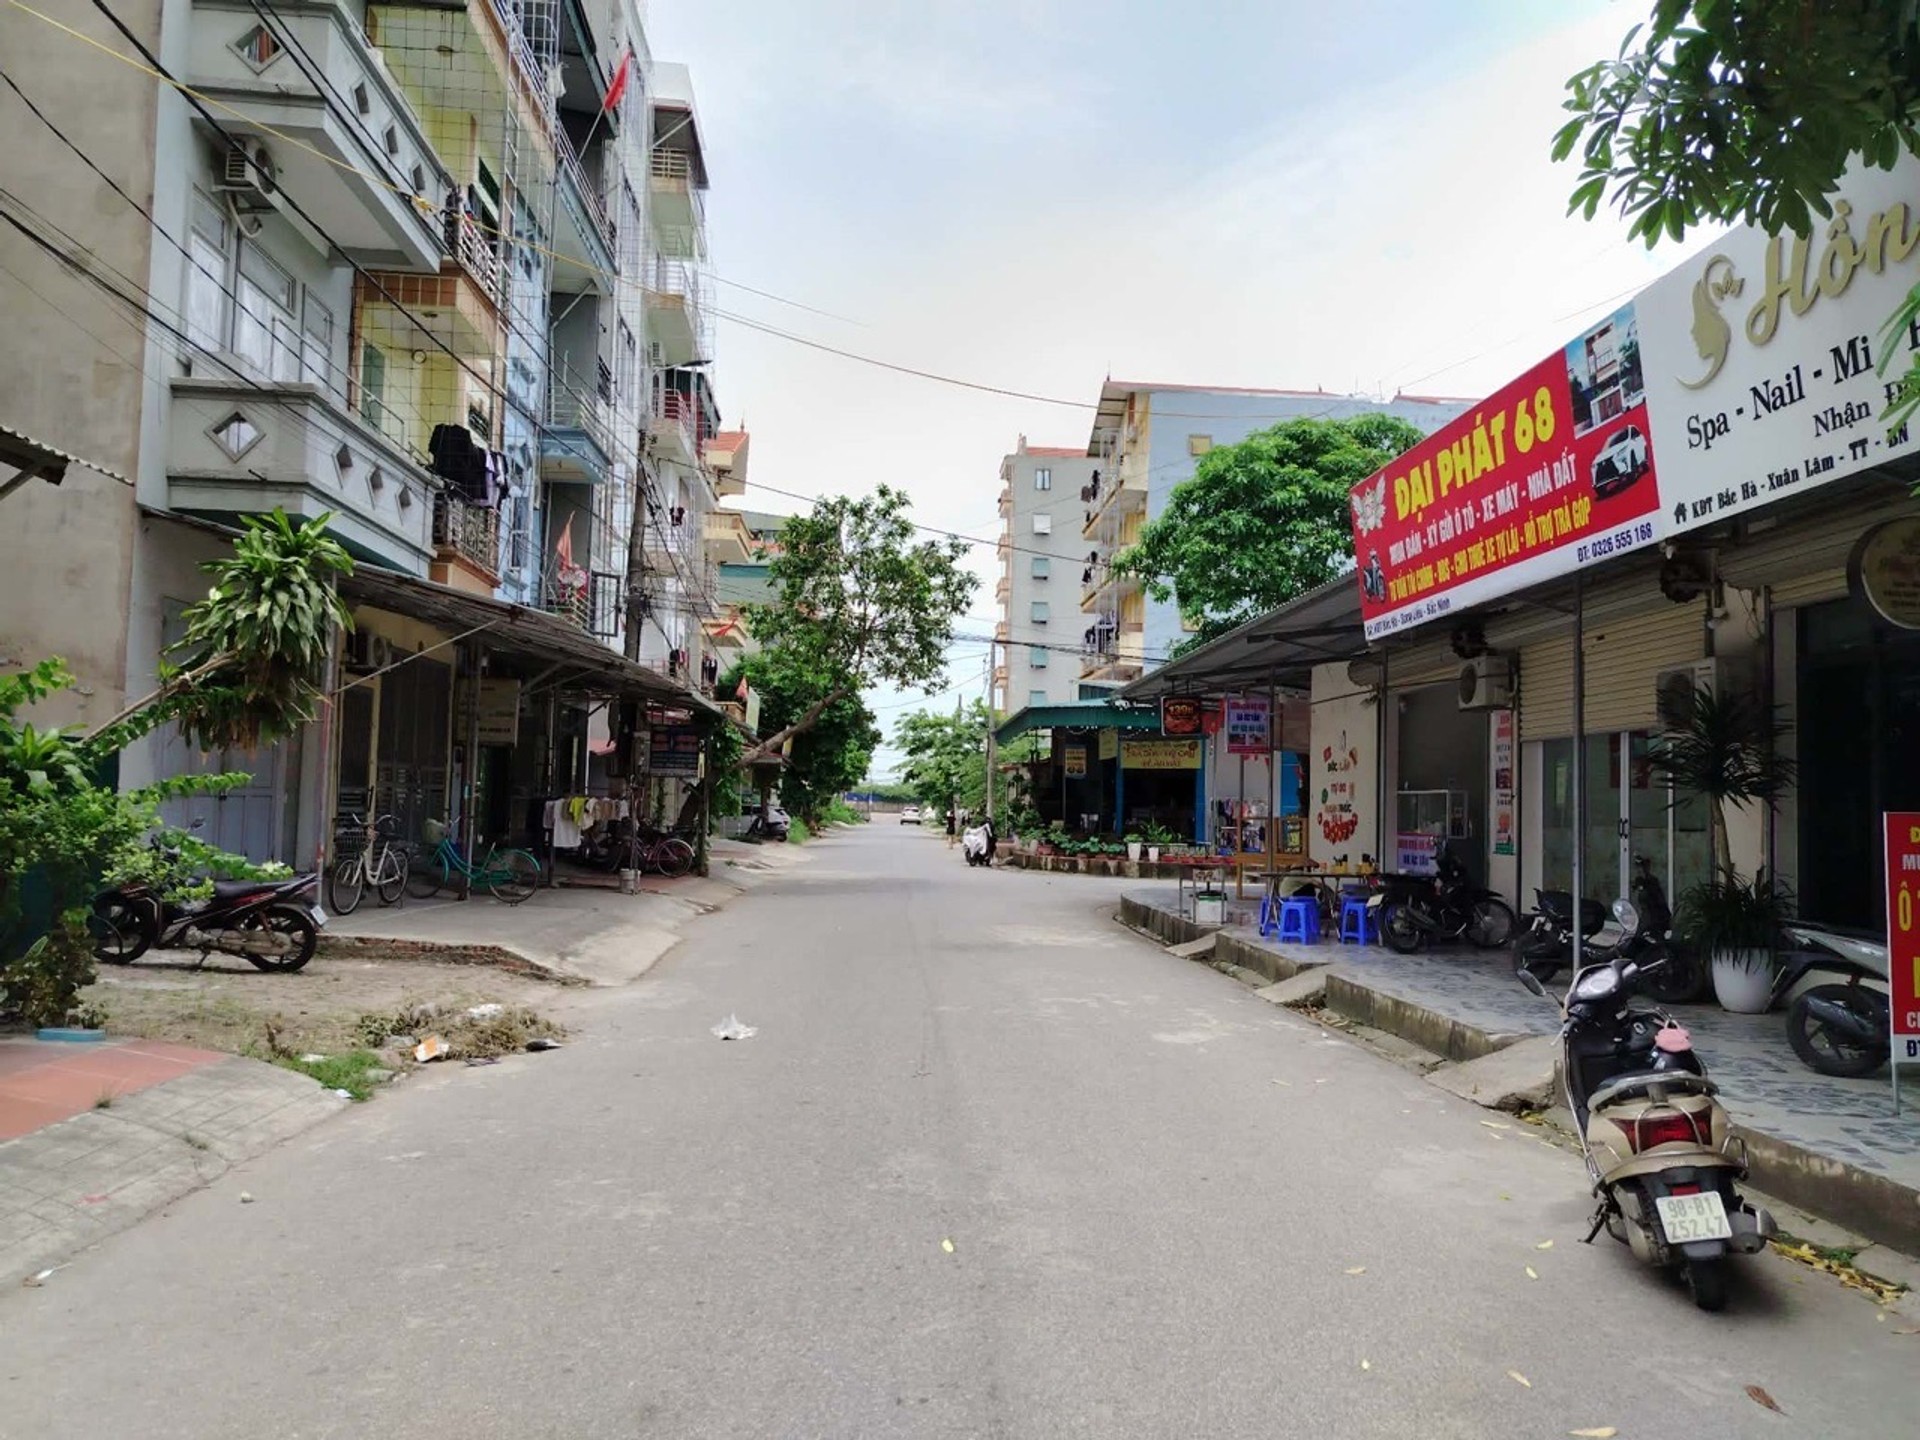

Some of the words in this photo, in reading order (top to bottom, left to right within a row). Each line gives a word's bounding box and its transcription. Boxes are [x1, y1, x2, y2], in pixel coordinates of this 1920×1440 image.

[1686, 412, 1731, 450] Spa
[1750, 364, 1806, 421] Nail
[1829, 335, 1874, 384] Mi
[1812, 399, 1872, 437] Nhận
[1394, 459, 1435, 523] ĐẠI
[1436, 411, 1506, 498] PHÁT
[1514, 386, 1556, 454] 68
[1462, 500, 1475, 532] TÔ
[1481, 494, 1496, 523] XE
[1495, 480, 1518, 516] MÁY
[1527, 461, 1553, 502] NHÀ
[1553, 446, 1576, 490] ĐẤT
[1692, 496, 1713, 518] KĐT
[1741, 480, 1758, 501] Hà
[1767, 468, 1800, 492] Xuân
[1804, 453, 1835, 479] Lâm
[1848, 437, 1870, 461] TT
[1553, 495, 1573, 537] TRẢ
[1615, 529, 1633, 549] 555
